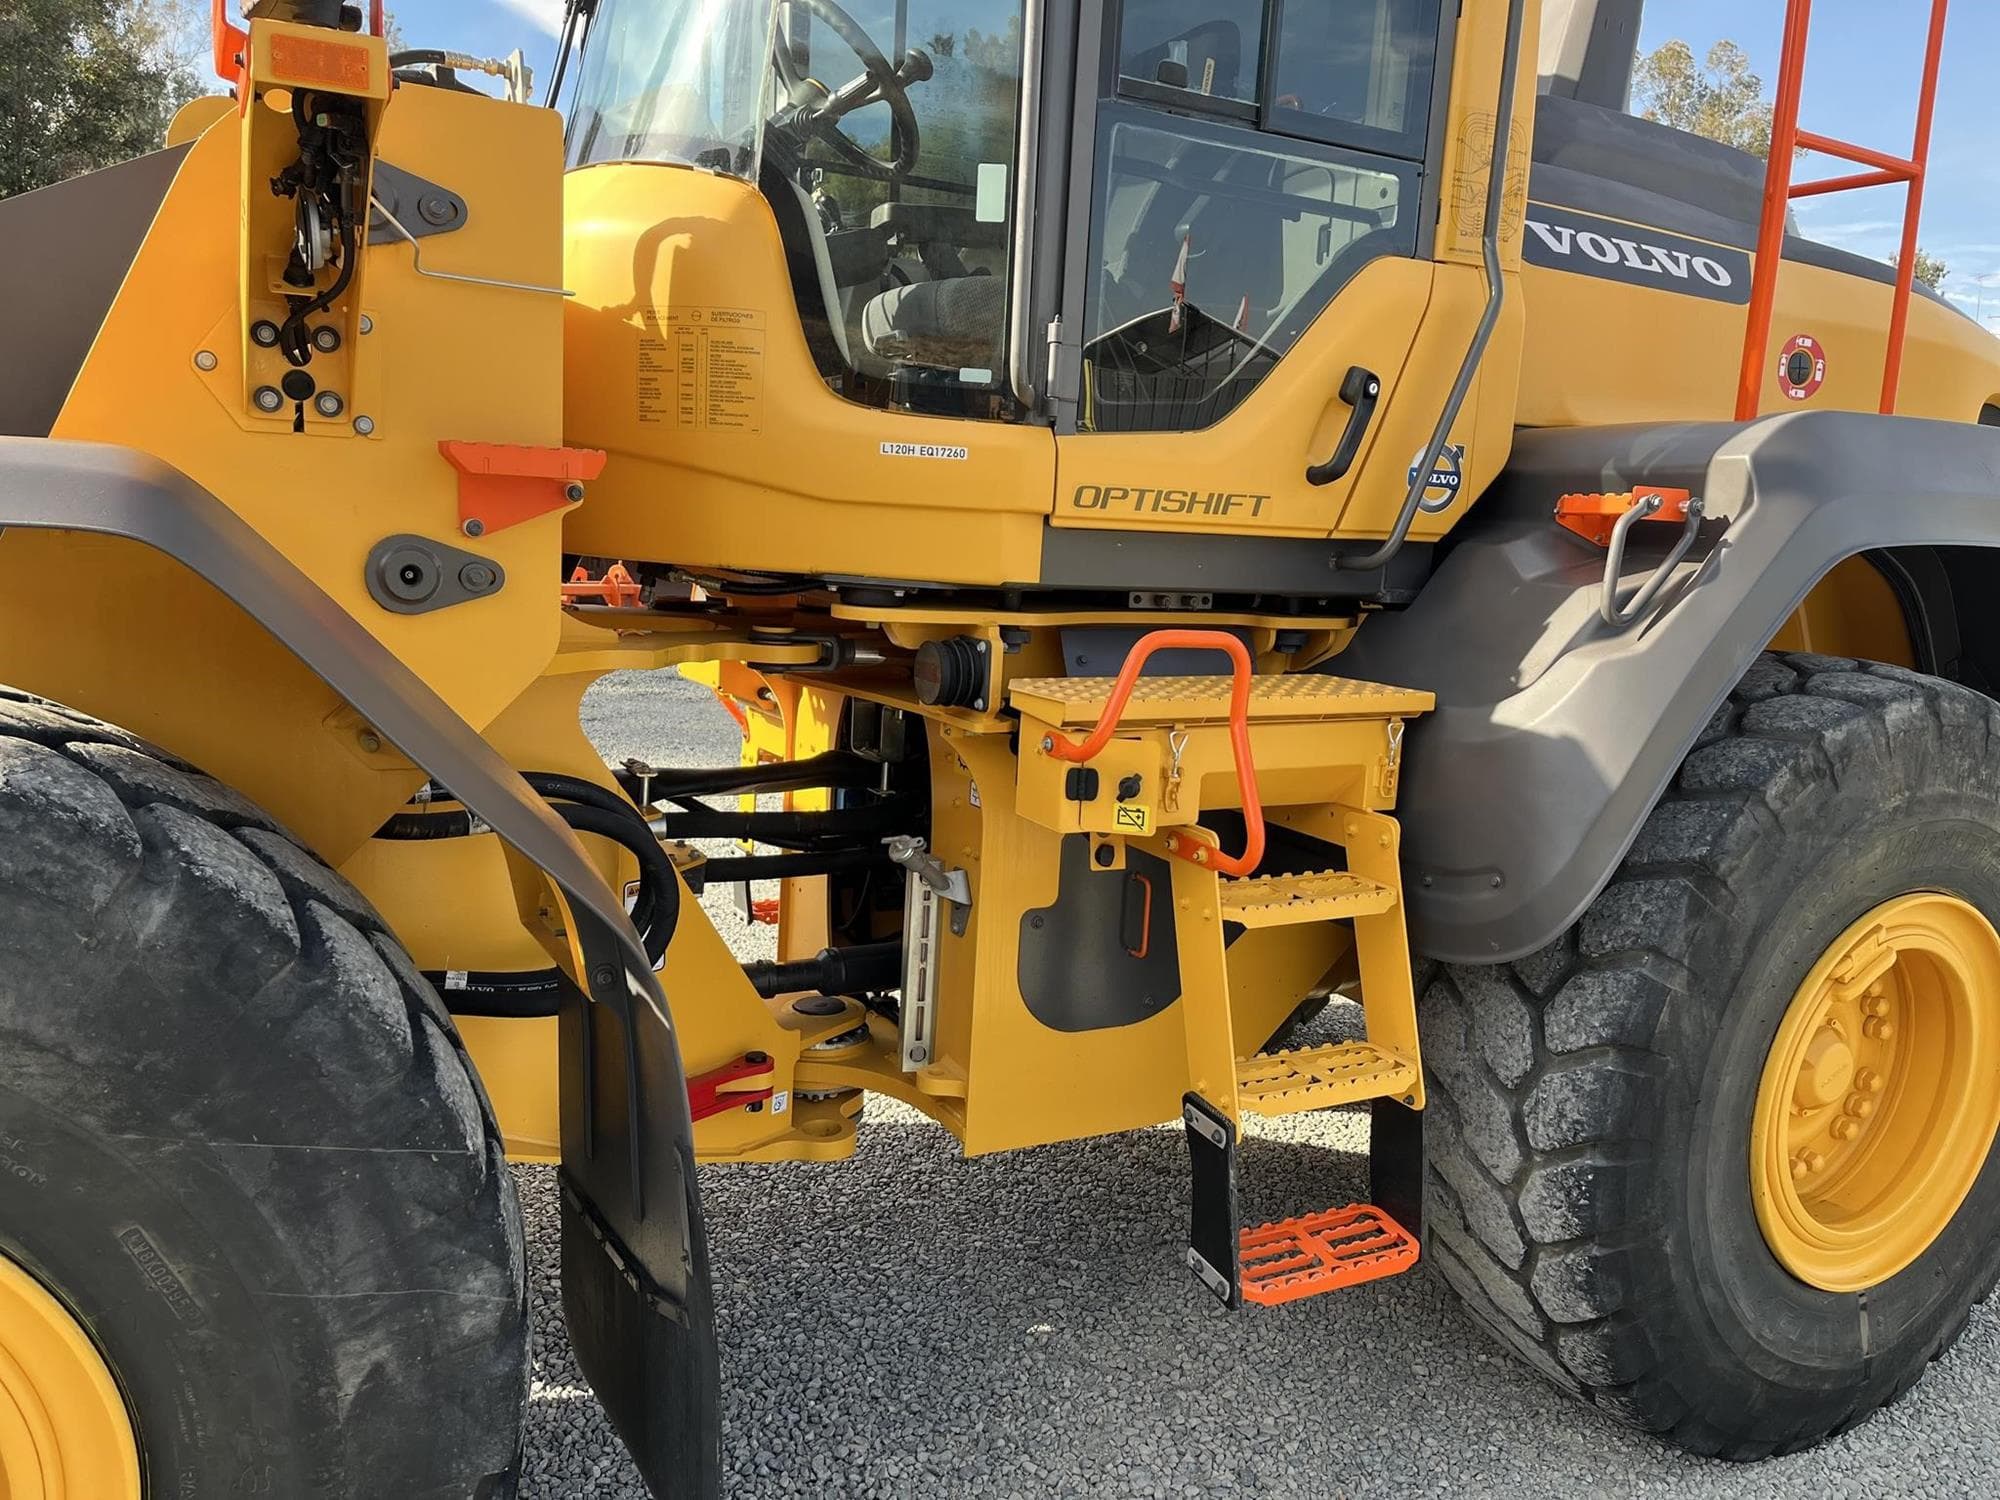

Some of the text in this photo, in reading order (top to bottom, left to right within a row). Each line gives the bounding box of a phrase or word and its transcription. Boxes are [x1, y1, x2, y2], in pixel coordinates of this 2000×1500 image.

[1525, 220, 1732, 287] VOLVO
[882, 444, 966, 459] L120H EQ17260
[1412, 471, 1458, 485] LVO
[1073, 485, 1271, 517] OPTISHIFT
